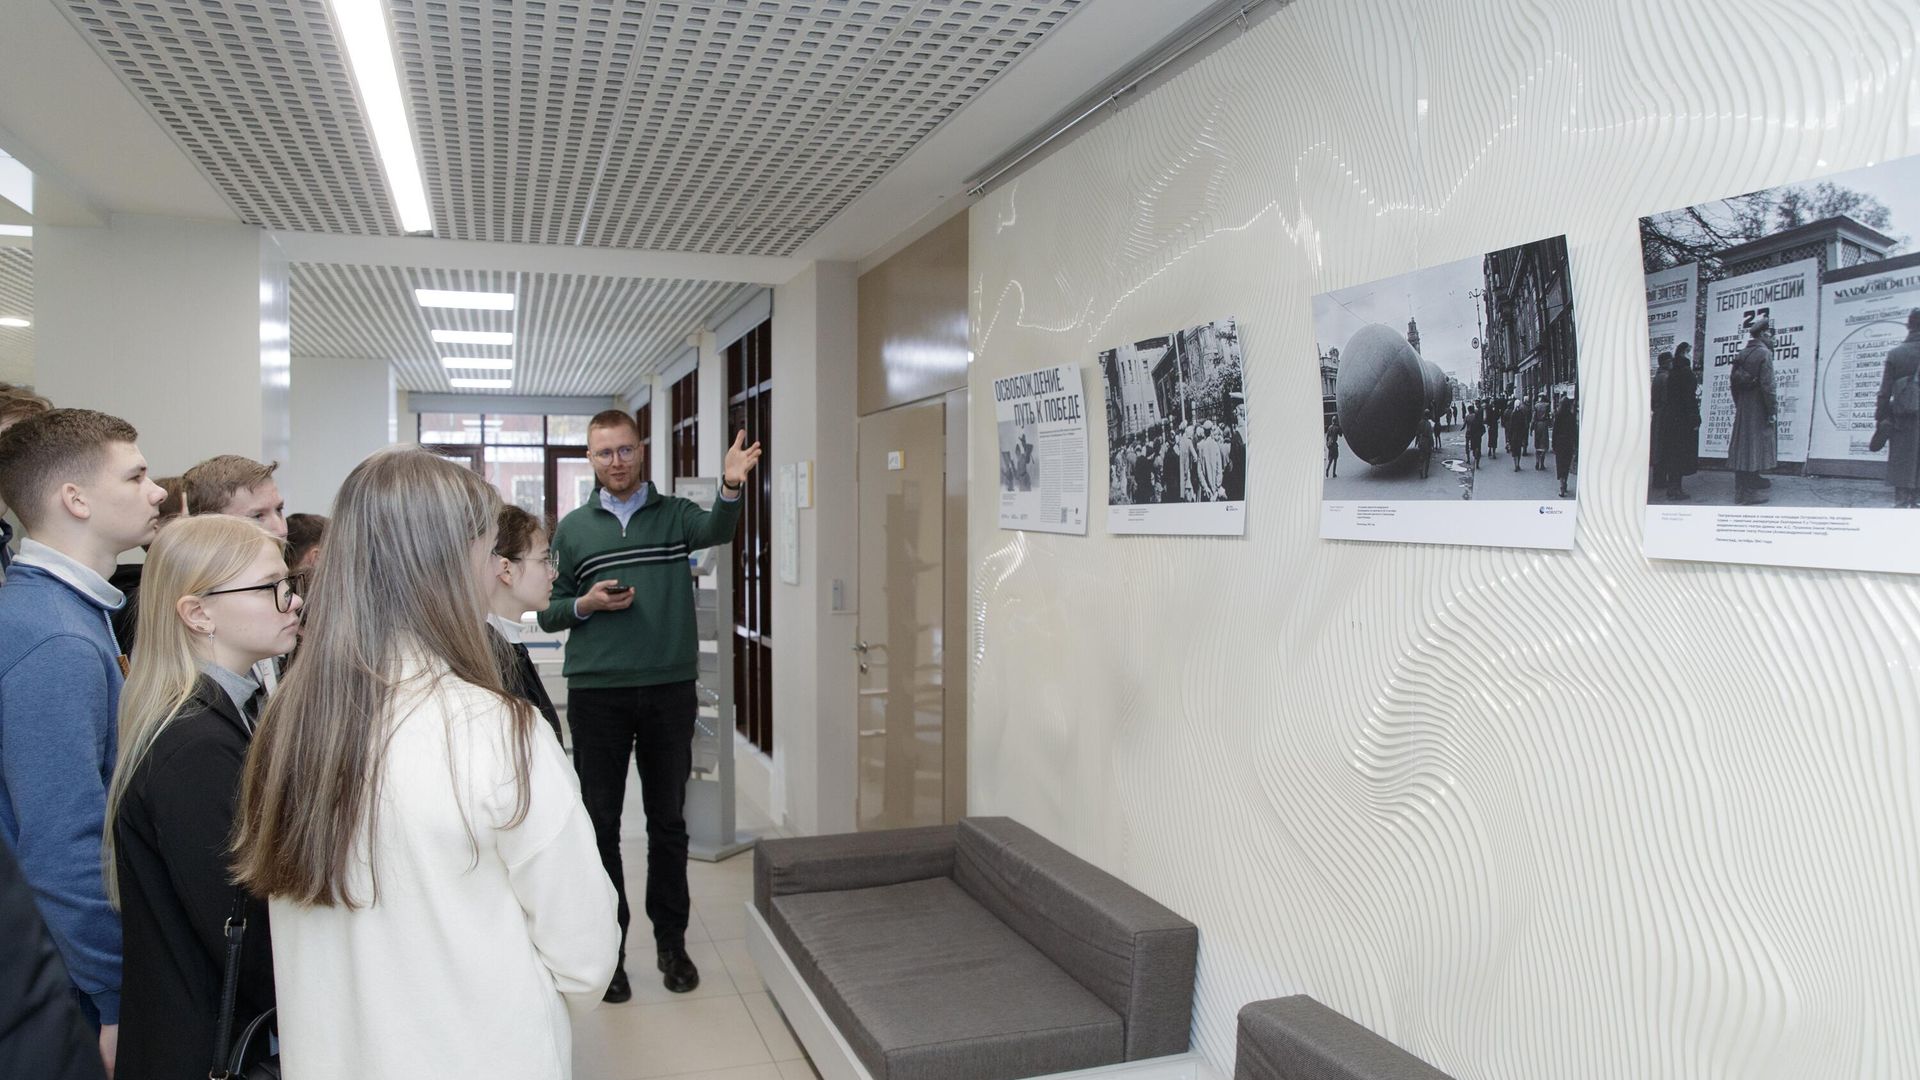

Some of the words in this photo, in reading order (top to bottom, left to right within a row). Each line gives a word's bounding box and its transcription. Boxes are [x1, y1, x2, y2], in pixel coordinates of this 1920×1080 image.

[1716, 291, 1748, 312] ТЕАТР
[1750, 279, 1805, 306] КОМЕДИИ
[995, 368, 1064, 402] ОСВОБОЖДЕНИЕ.
[1014, 402, 1035, 429] ПУТЬ
[1036, 400, 1044, 423] К
[1044, 394, 1081, 424] ПОБЕДЕ
